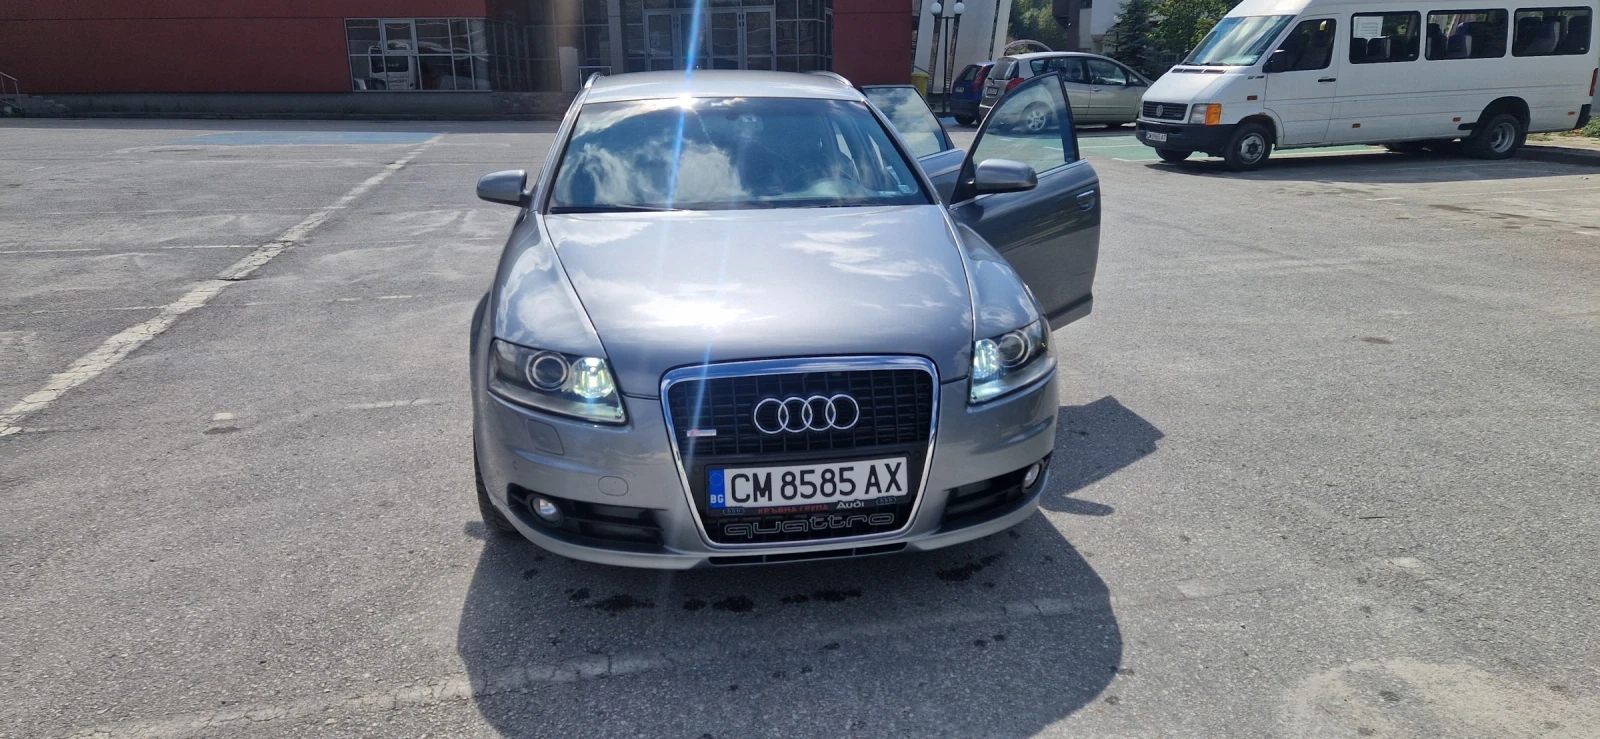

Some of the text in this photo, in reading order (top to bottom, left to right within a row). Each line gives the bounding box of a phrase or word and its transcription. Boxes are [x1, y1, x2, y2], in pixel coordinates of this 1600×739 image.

[731, 462, 902, 504] CM 8585 AX
[710, 494, 724, 504] BG
[800, 504, 828, 512] ГРУПА
[836, 500, 865, 510] Audi
[725, 513, 894, 538] quattro
